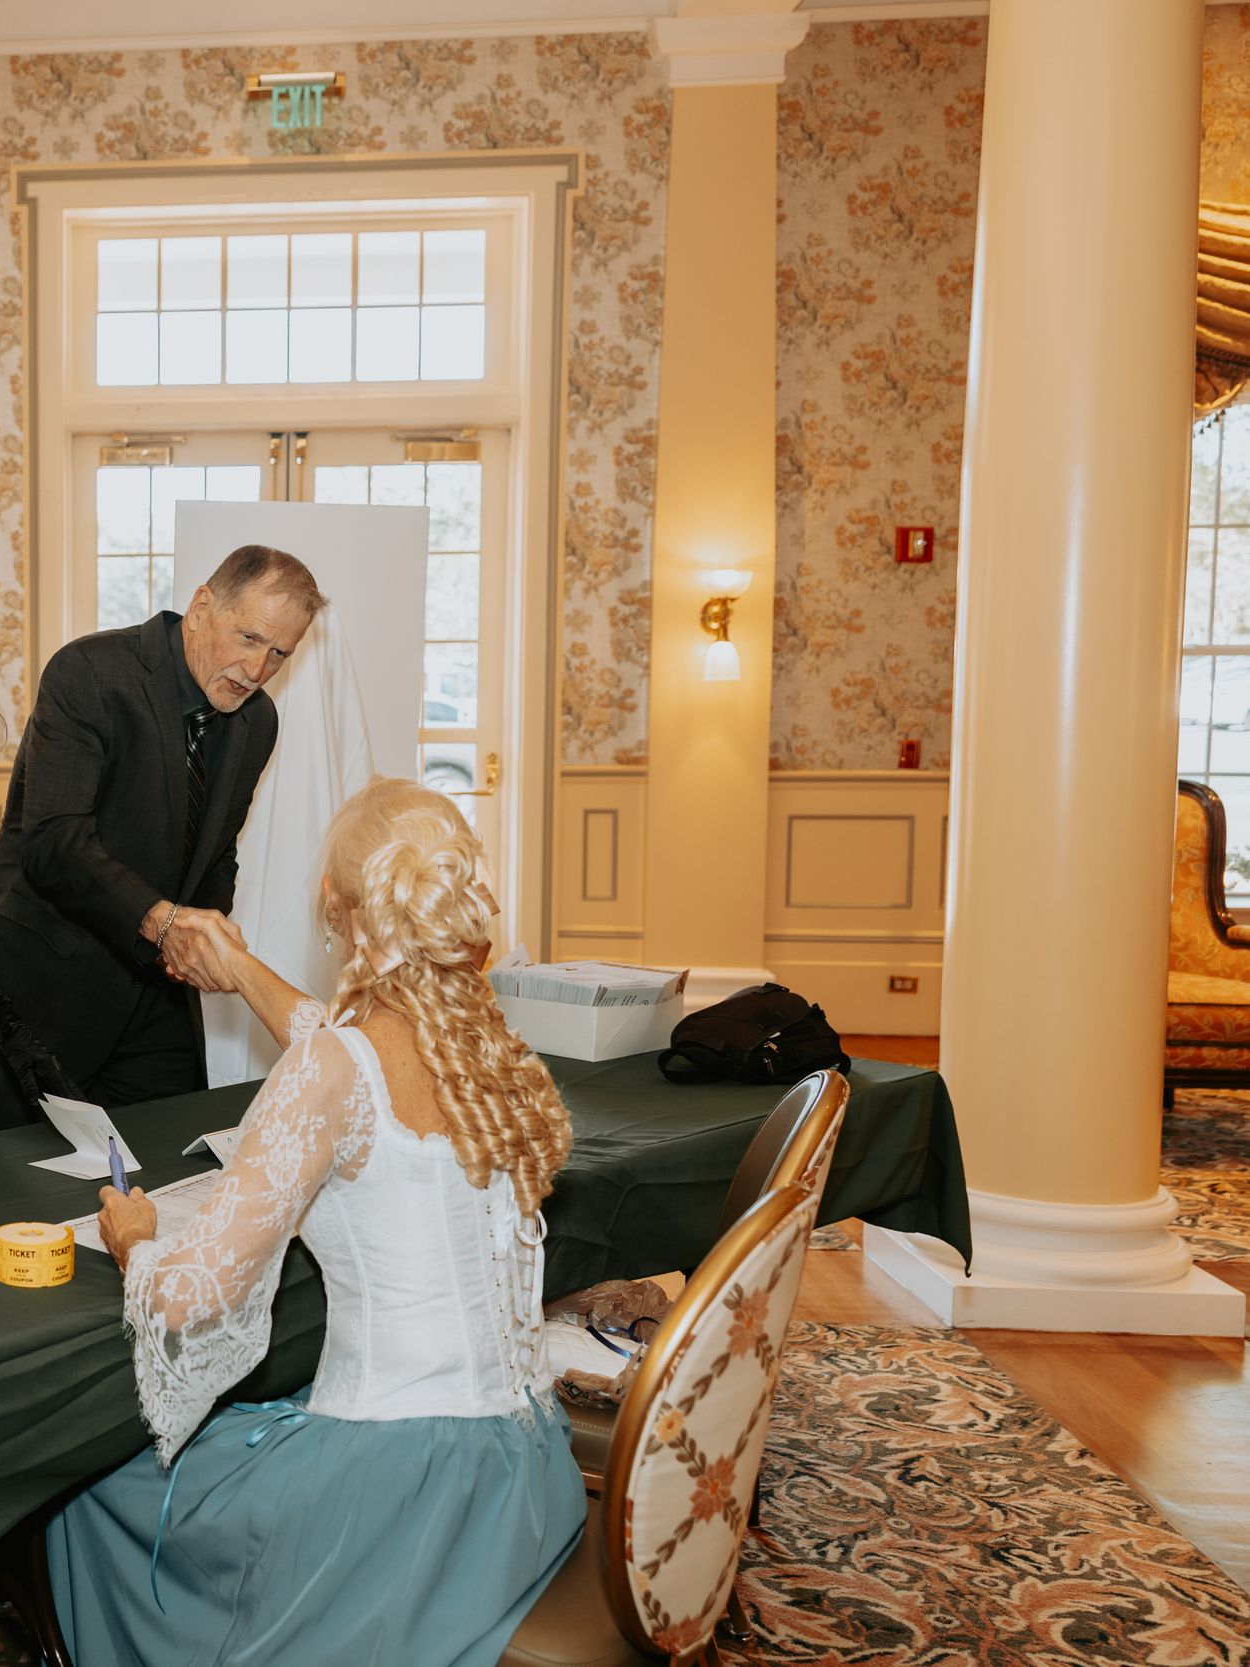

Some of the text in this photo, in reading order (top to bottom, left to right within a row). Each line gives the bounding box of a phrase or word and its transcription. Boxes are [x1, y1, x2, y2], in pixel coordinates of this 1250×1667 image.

[272, 84, 326, 128] EXIT
[9, 1248, 36, 1258] TICKET
[51, 1245, 71, 1257] TICKET
